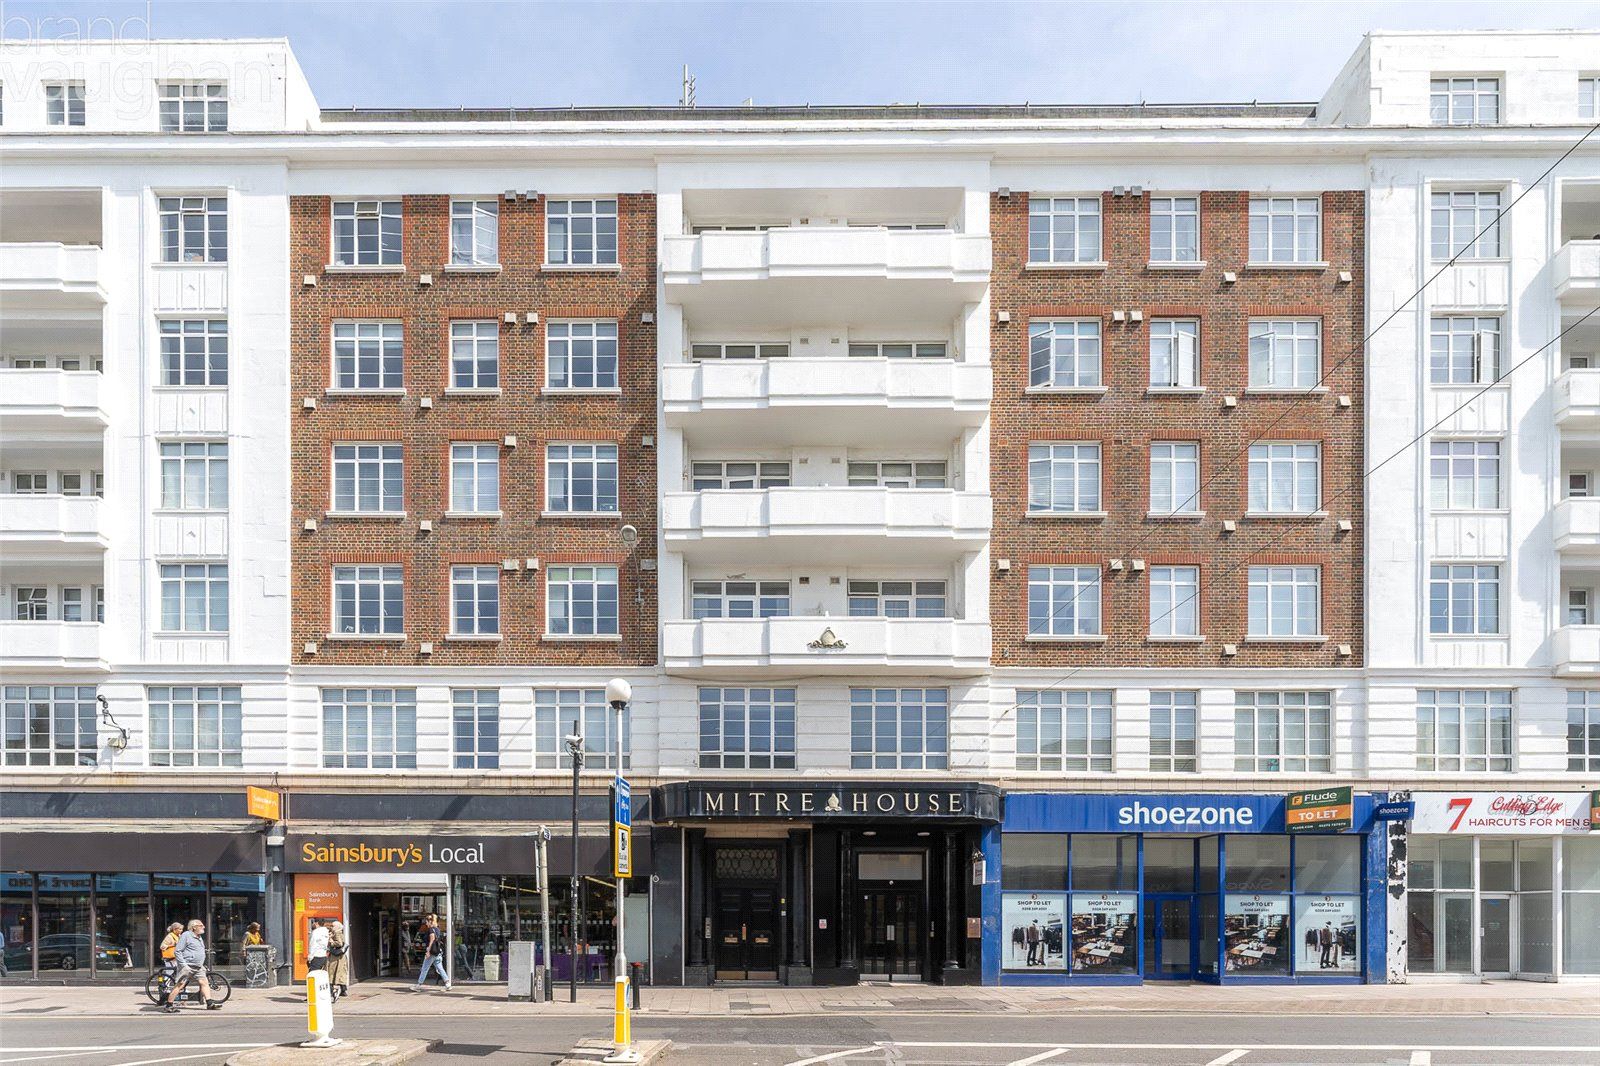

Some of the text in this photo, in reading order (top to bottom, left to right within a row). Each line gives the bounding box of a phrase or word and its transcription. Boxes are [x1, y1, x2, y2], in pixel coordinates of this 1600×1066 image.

[706, 793, 962, 812] MITRE HOUSE
[1304, 792, 1337, 801] Flude
[1536, 796, 1564, 815] Edge
[1119, 801, 1253, 824] shoezone
[1298, 810, 1338, 820] TO LET
[1380, 807, 1409, 815] shoezone
[1447, 798, 1472, 832] 7
[1469, 818, 1526, 827] HAIRCUTS
[1530, 818, 1553, 827] FOR
[1556, 818, 1580, 827] MEN
[302, 843, 485, 867] Sainsbury's Local
